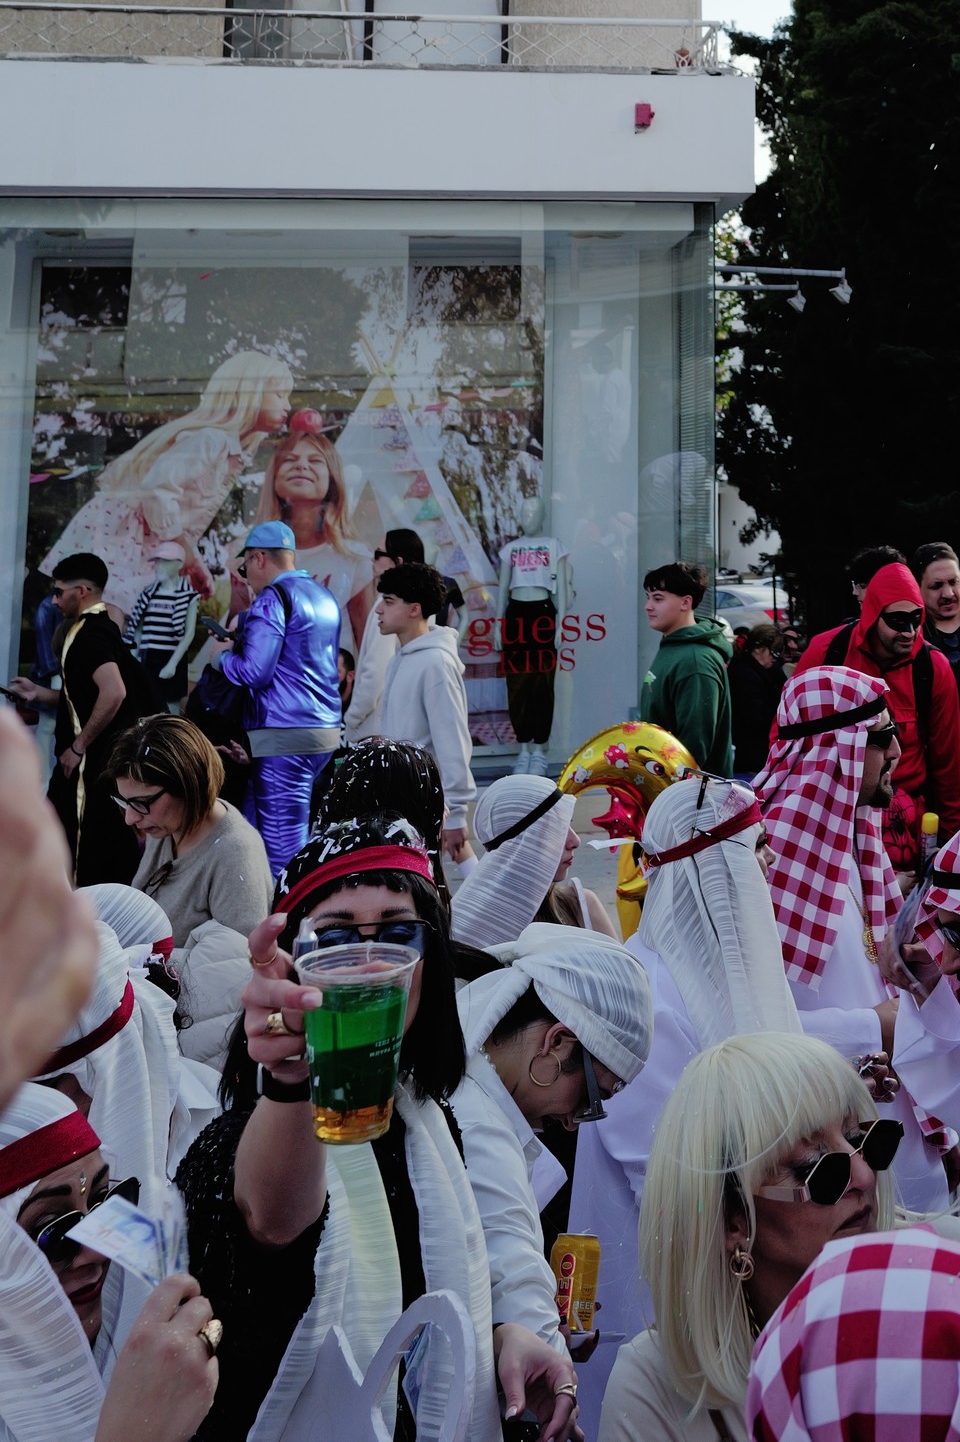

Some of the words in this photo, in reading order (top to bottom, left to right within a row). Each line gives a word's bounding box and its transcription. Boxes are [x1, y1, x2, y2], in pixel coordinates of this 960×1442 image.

[467, 613, 607, 657] guess
[499, 647, 576, 676] KIDS
[556, 1253, 575, 1316] KEO
